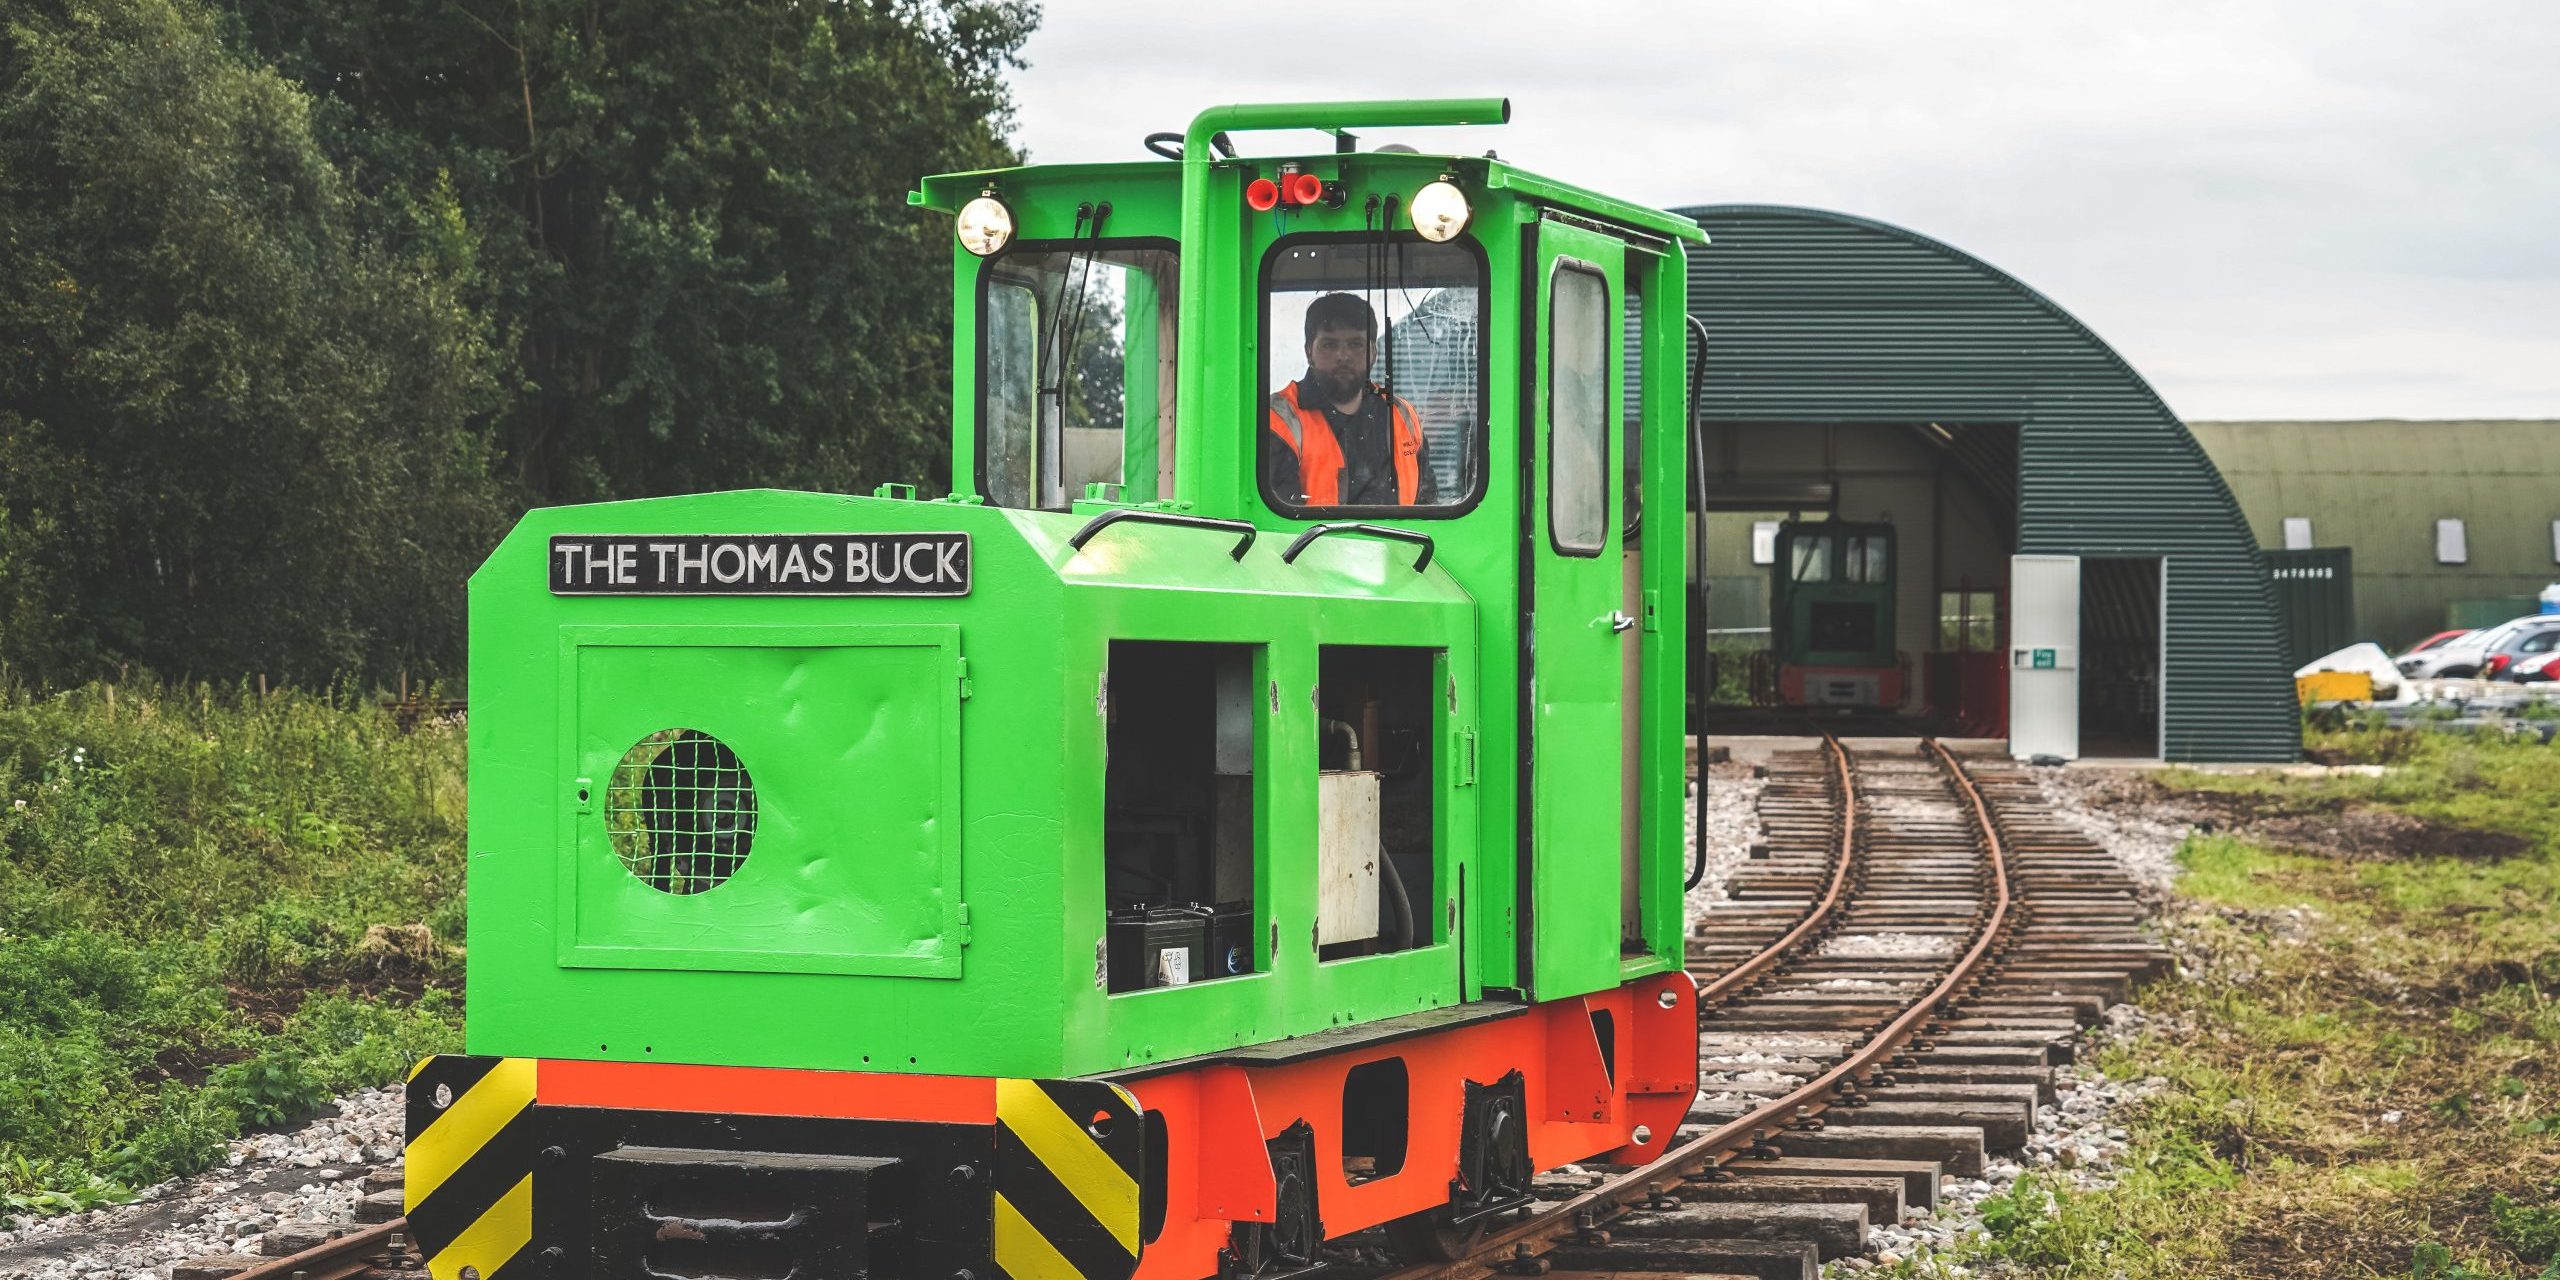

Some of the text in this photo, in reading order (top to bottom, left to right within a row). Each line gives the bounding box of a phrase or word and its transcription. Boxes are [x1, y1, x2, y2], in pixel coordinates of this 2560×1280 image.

[555, 542, 964, 584] THE THOMAS BUCK
